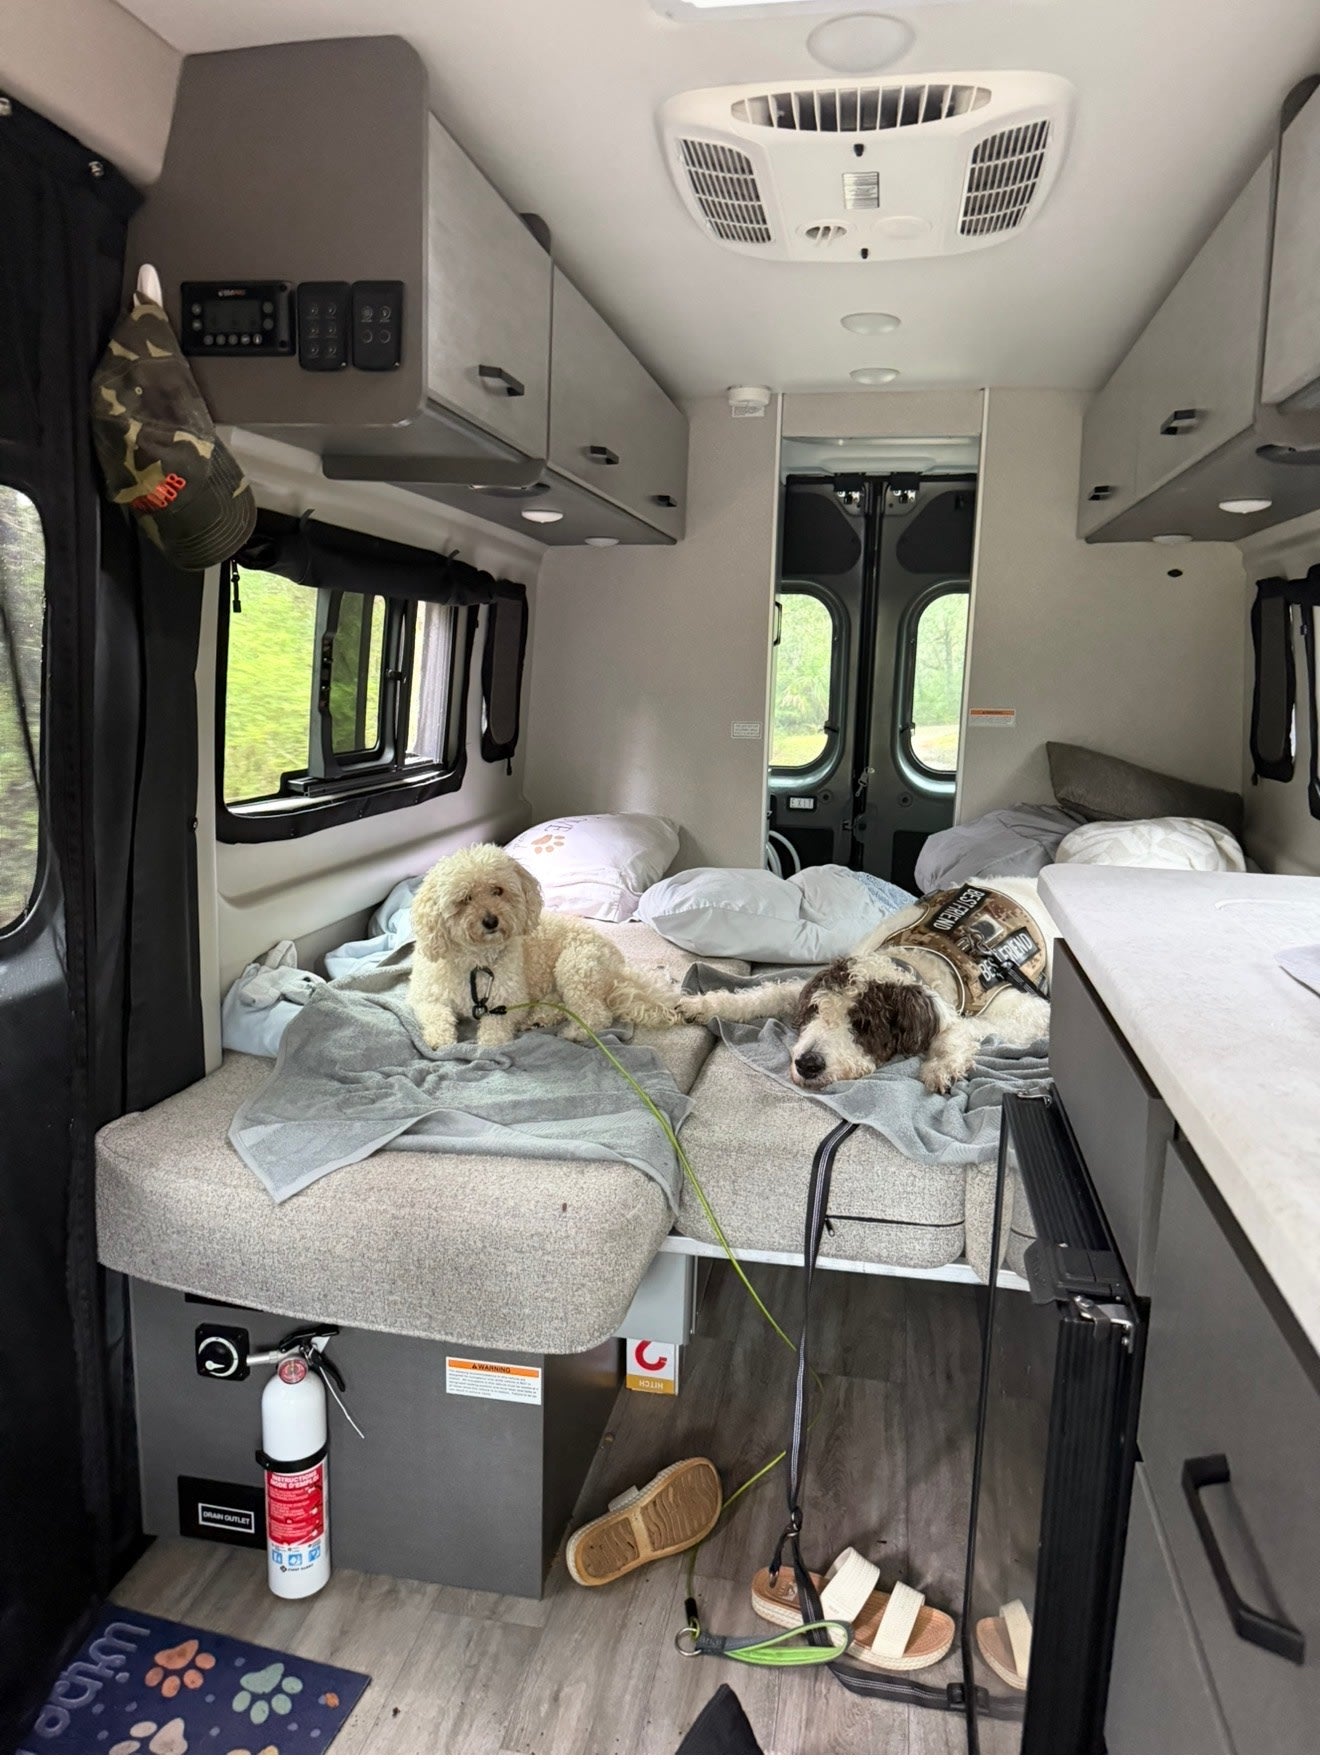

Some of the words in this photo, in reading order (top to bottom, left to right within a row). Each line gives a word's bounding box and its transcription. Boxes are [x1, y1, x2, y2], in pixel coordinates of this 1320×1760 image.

[957, 888, 985, 909] BEST
[933, 903, 969, 931] FRIEND
[997, 932, 1034, 962] FRIEND
[478, 1363, 511, 1374] WARNING
[639, 1379, 664, 1390] HITCH
[203, 1511, 223, 1520] DRAIN
[224, 1514, 250, 1525] OUTLET
